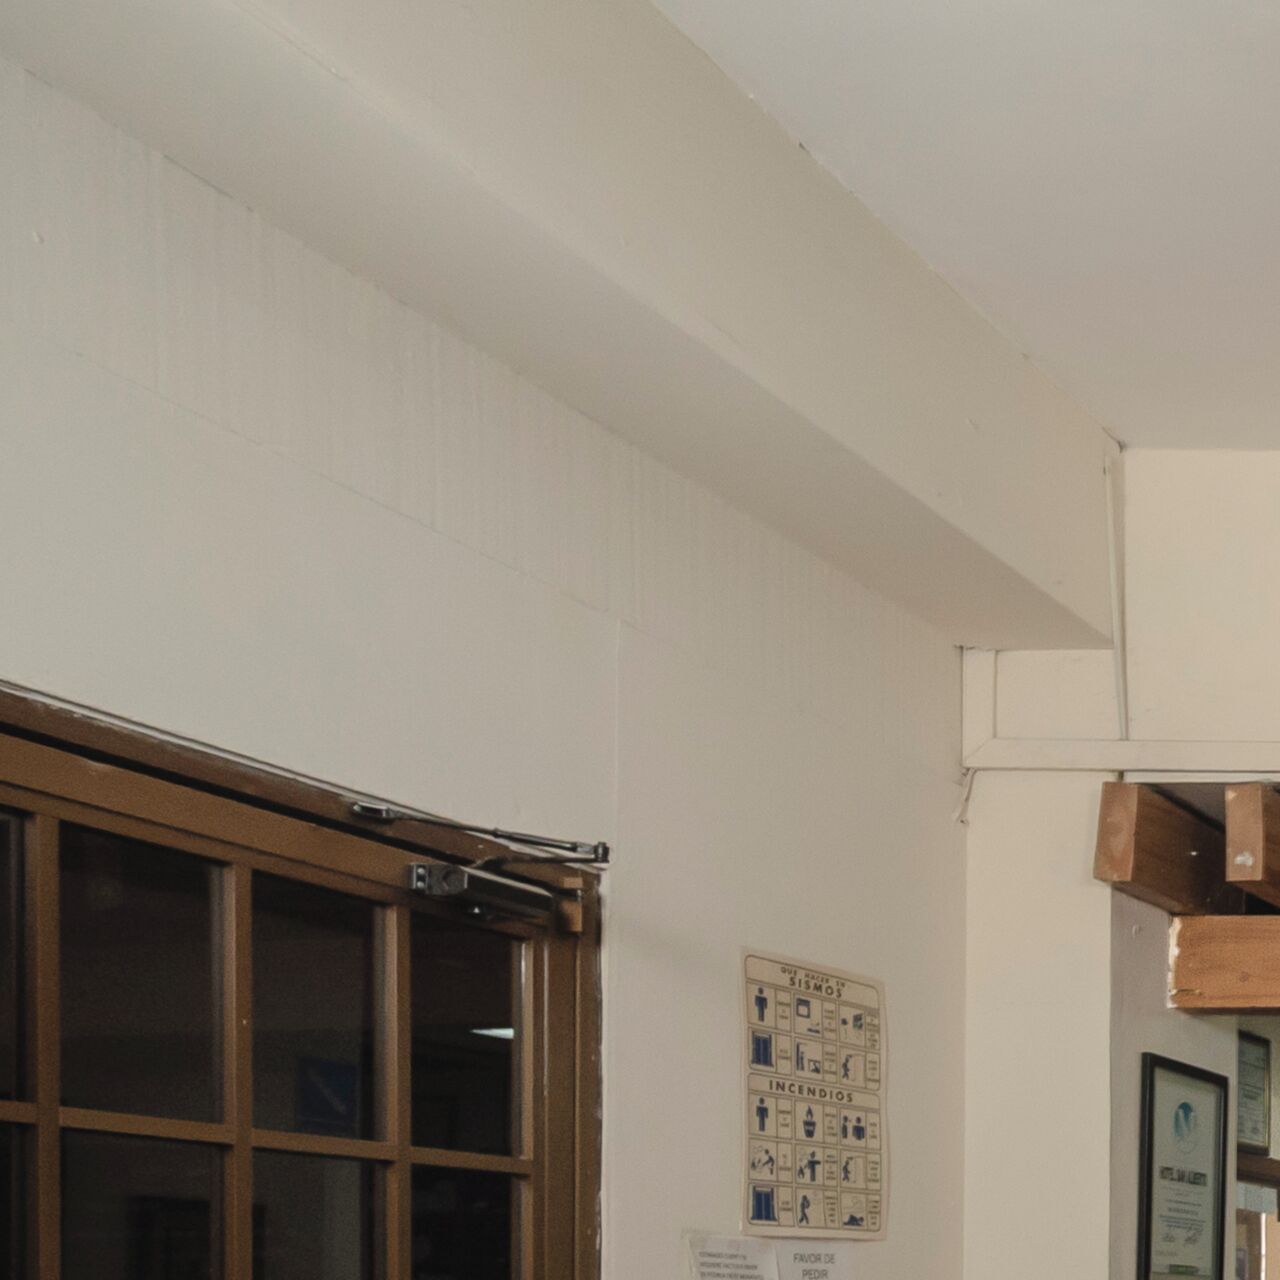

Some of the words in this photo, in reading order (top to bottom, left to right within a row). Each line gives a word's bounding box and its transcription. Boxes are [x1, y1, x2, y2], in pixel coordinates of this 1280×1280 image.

[790, 976, 842, 998] SISMOS
[769, 1080, 853, 1102] INCENDIOS
[793, 1253, 822, 1264] FAVOR
[824, 1254, 835, 1264] DE
[802, 1269, 829, 1280] PEDIR
